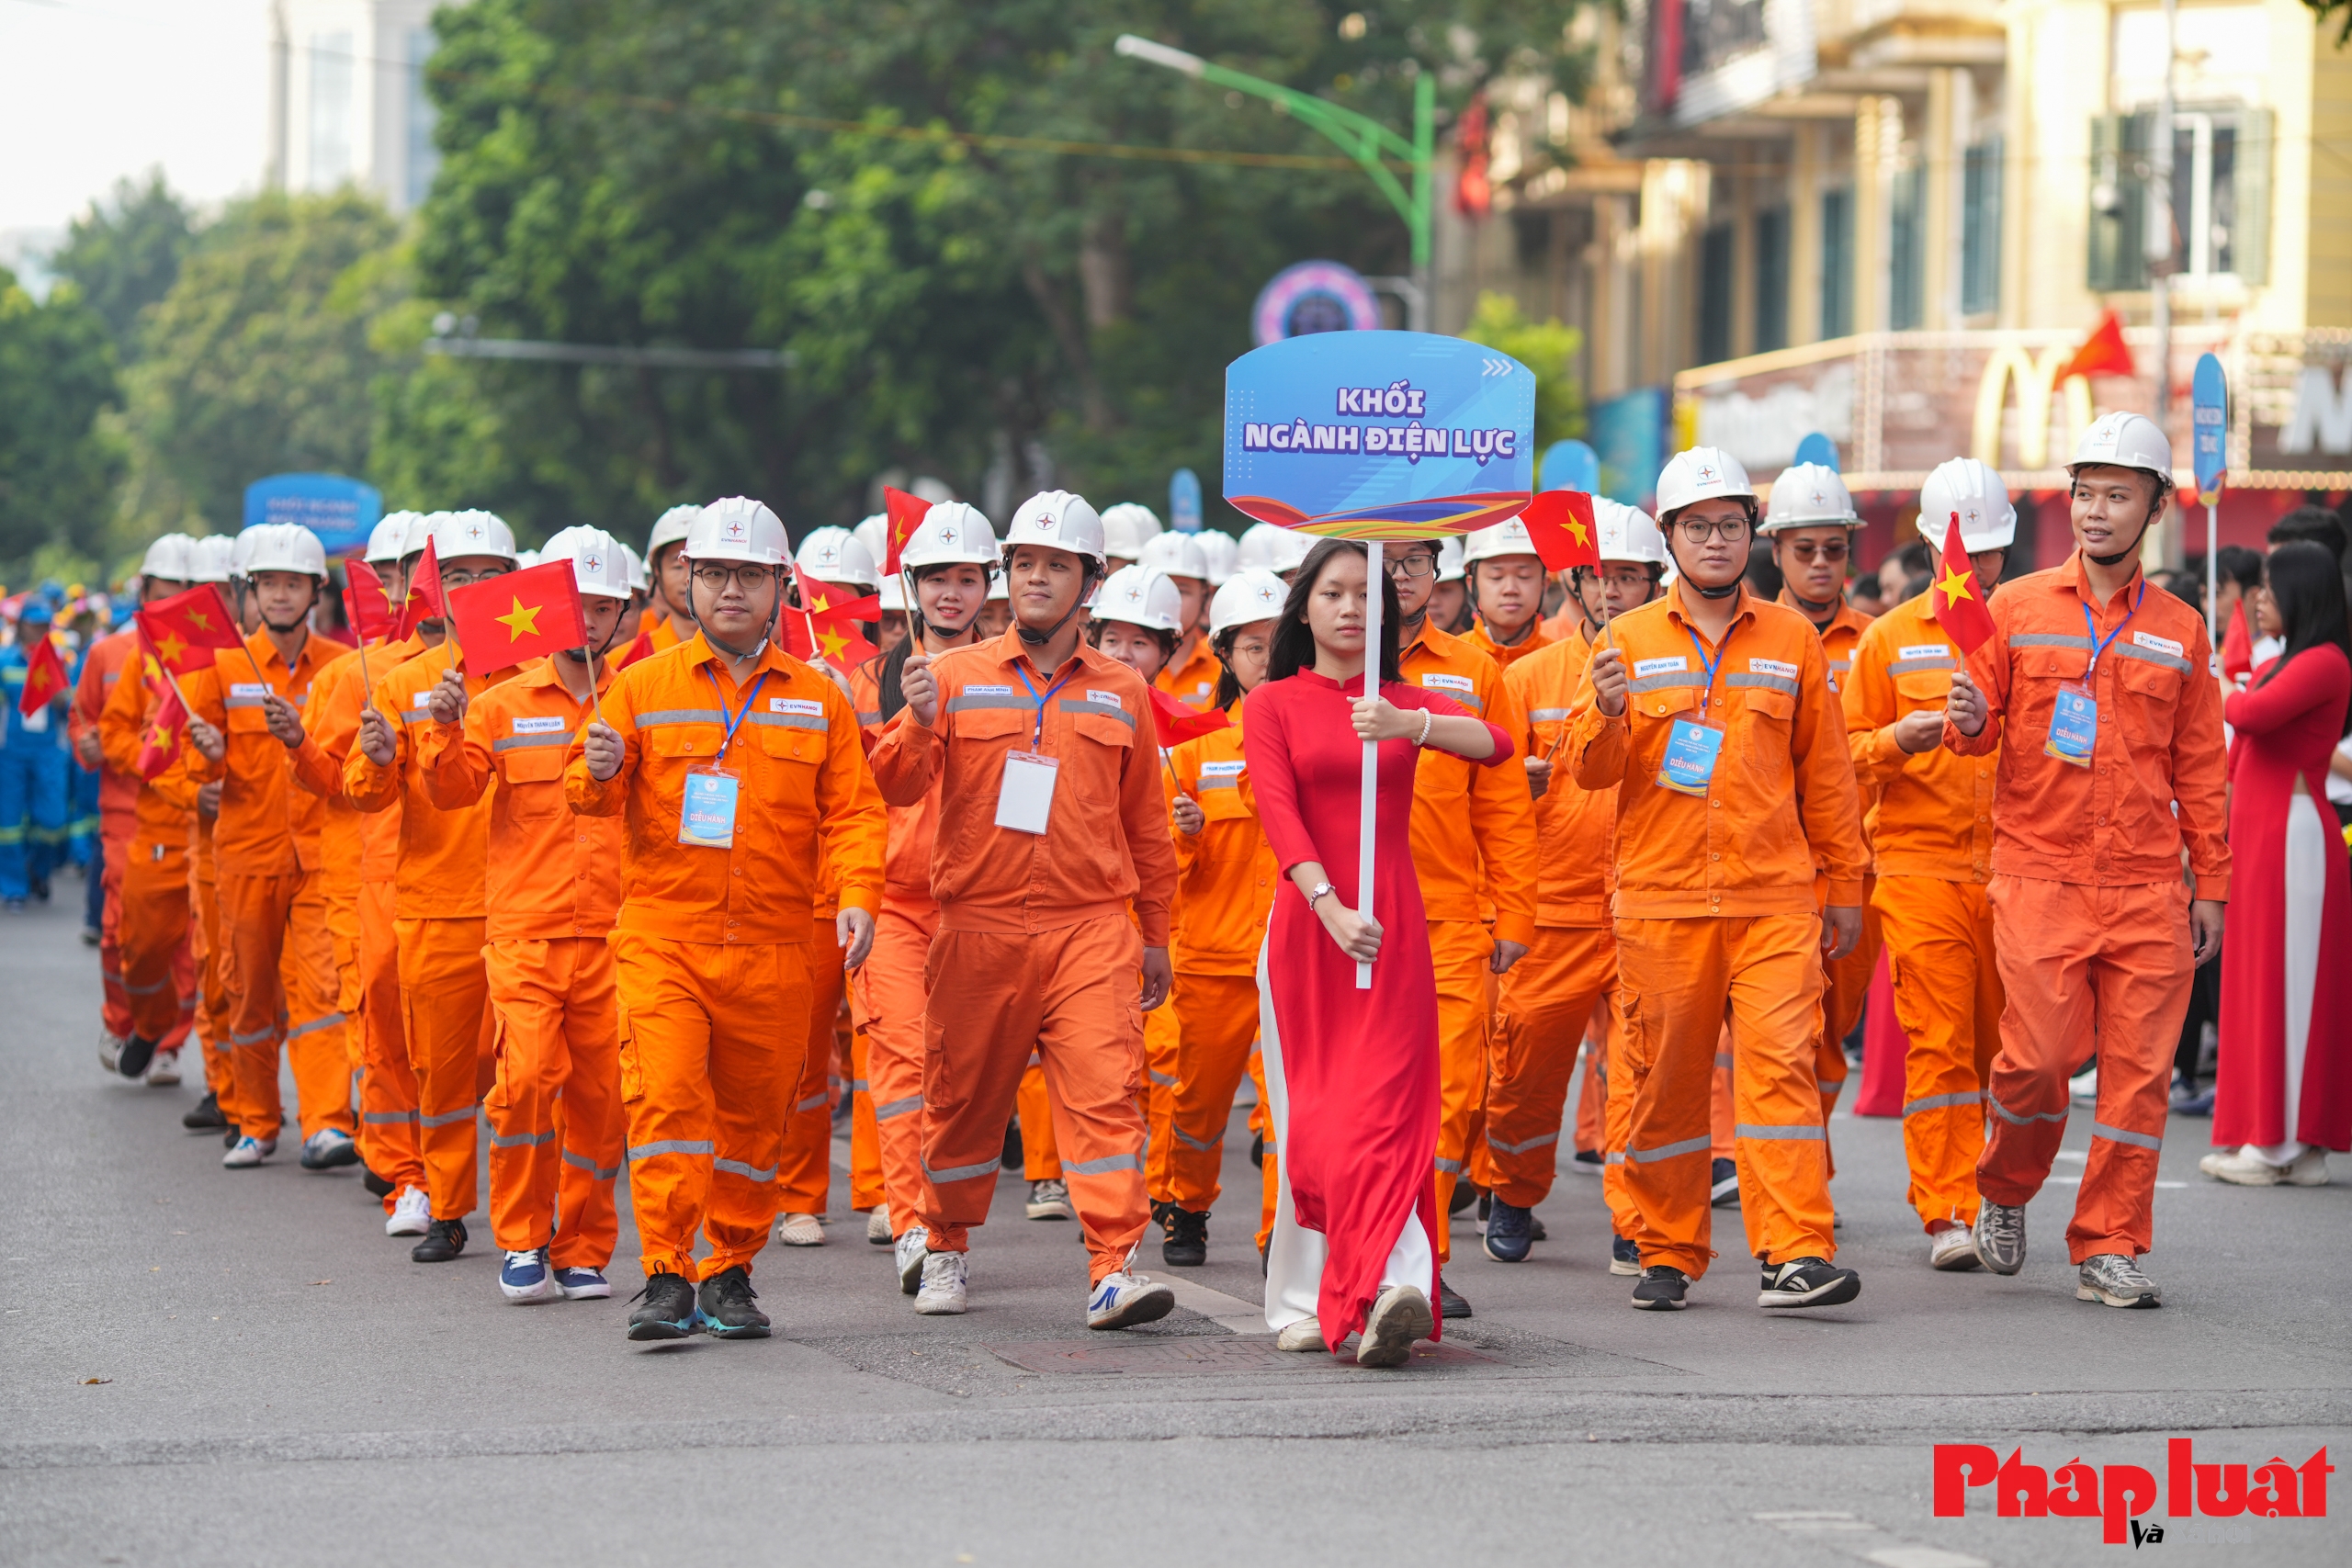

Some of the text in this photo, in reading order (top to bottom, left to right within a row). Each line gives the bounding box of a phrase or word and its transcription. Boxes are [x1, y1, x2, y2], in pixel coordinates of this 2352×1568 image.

[1338, 378, 1425, 415] KHỐI
[1244, 418, 1516, 465] NGÀNH ĐIỆN LỰC
[1764, 663, 1796, 674] EVNHANOI
[1442, 678, 1469, 687] EVNHANOI
[789, 704, 818, 712] EVNHANOI
